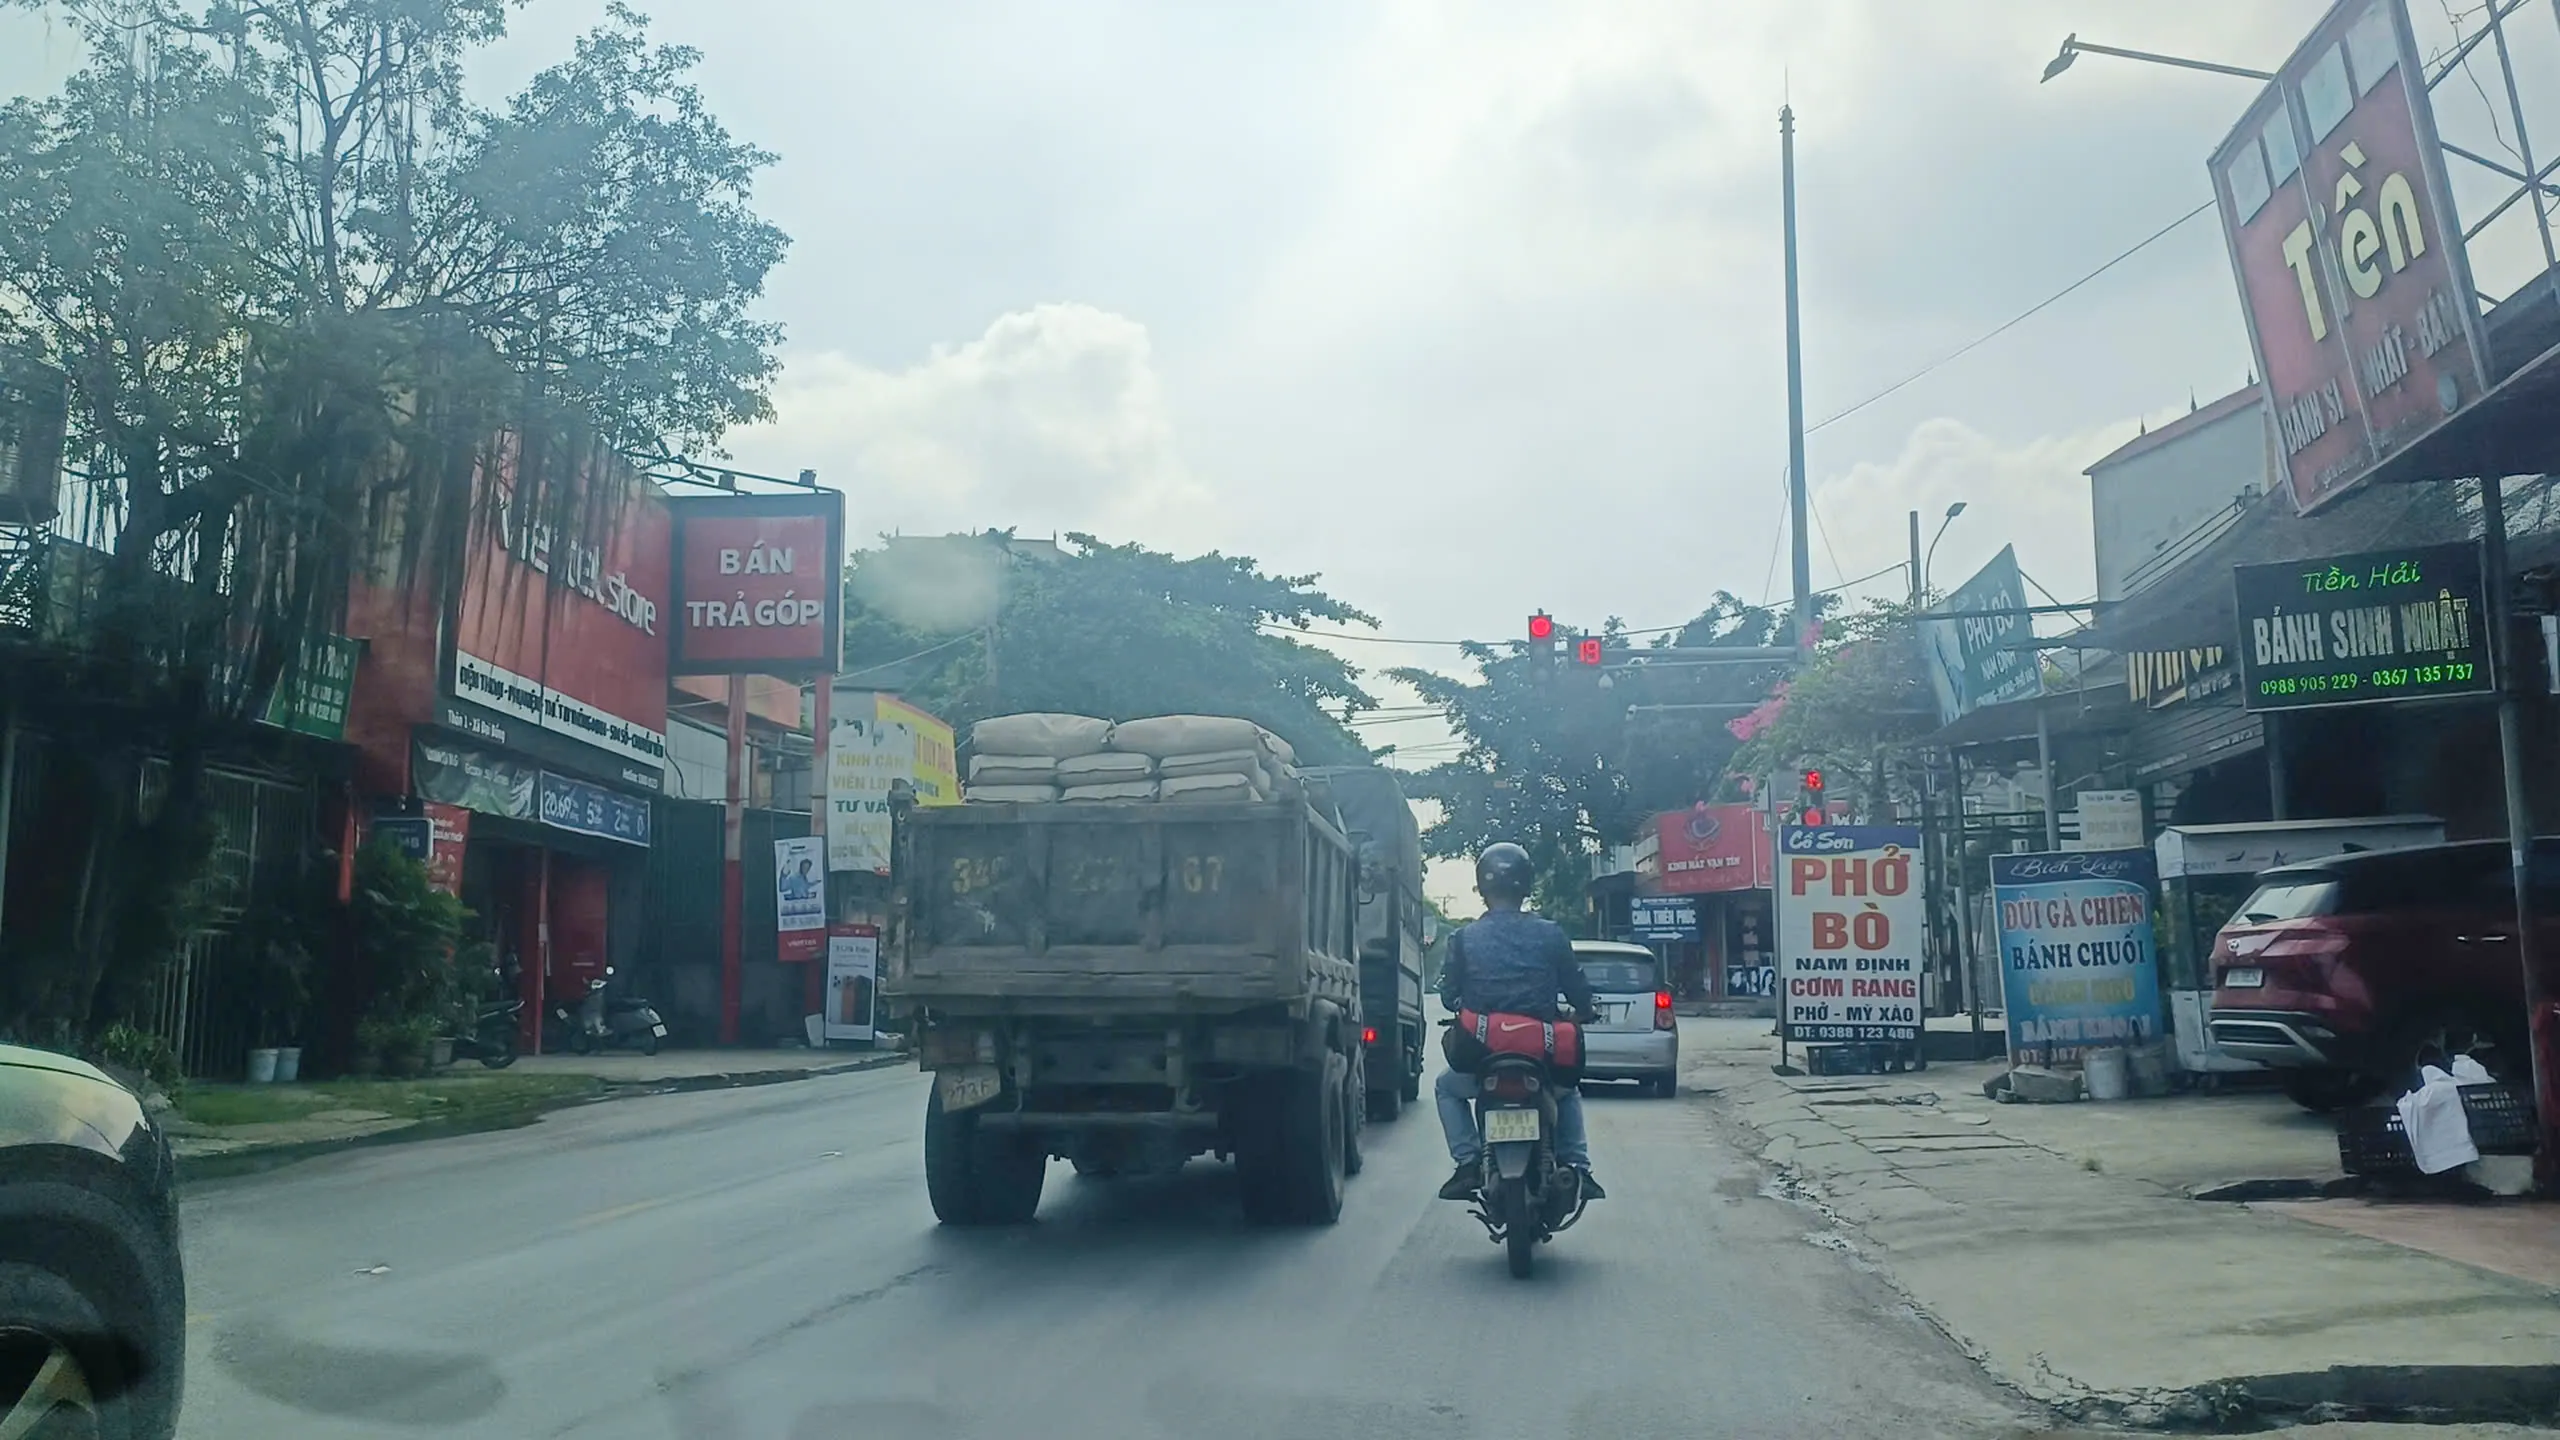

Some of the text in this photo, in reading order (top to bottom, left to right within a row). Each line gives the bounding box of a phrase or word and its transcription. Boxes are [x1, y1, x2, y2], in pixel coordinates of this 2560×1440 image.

[719, 539, 793, 575] BÁN
[2302, 561, 2421, 593] Tiền Hải
[686, 589, 821, 628] TRẢ GÓP
[2330, 605, 2394, 659] SINH
[2400, 588, 2471, 660] NHẬT
[1578, 639, 1601, 665] 19
[2260, 663, 2473, 695] 0988 905 229 0367 135 737
[835, 799, 860, 813] TƯ
[1788, 830, 1854, 850] Cô Sơn
[1791, 845, 1911, 896] PHỞ
[2046, 891, 2077, 929] GÀ
[1812, 902, 1890, 951] BÒ
[1795, 958, 1910, 974] NAM ĐỊNH
[2012, 930, 2147, 971] BÁNH CHUỐI
[1790, 976, 1917, 998] CƠM RANG
[1793, 1001, 1829, 1021] PHỞ
[1846, 1003, 1873, 1021] MỲ
[1819, 1026, 1854, 1039] 0388
[1858, 1026, 1884, 1039] 123
